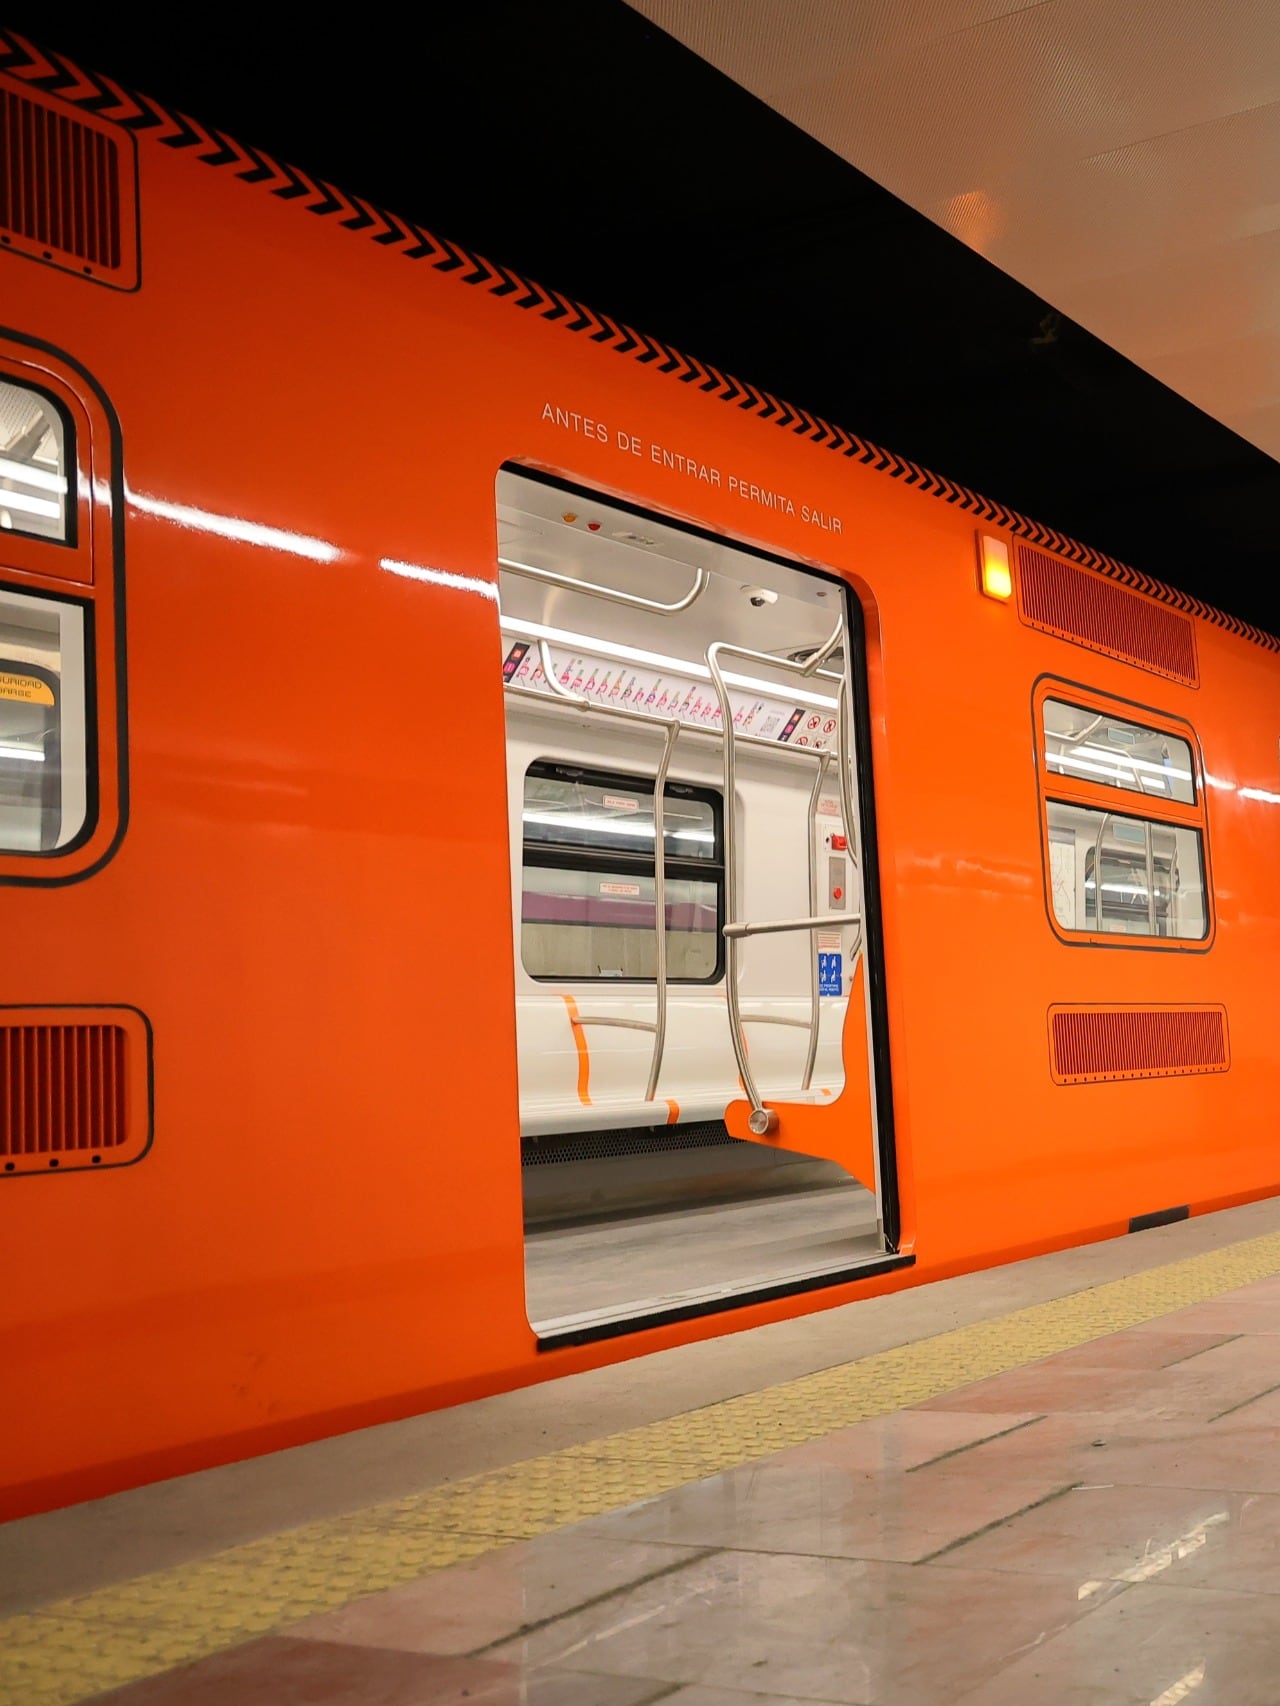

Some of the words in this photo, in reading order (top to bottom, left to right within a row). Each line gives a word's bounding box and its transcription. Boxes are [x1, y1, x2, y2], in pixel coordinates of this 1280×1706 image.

[542, 402, 609, 443] ANTES
[617, 431, 643, 457] DE
[651, 444, 721, 488] ENTRAR
[728, 475, 796, 517] PERMITA
[801, 505, 843, 535] SALIR
[0, 676, 42, 689] URIDAD
